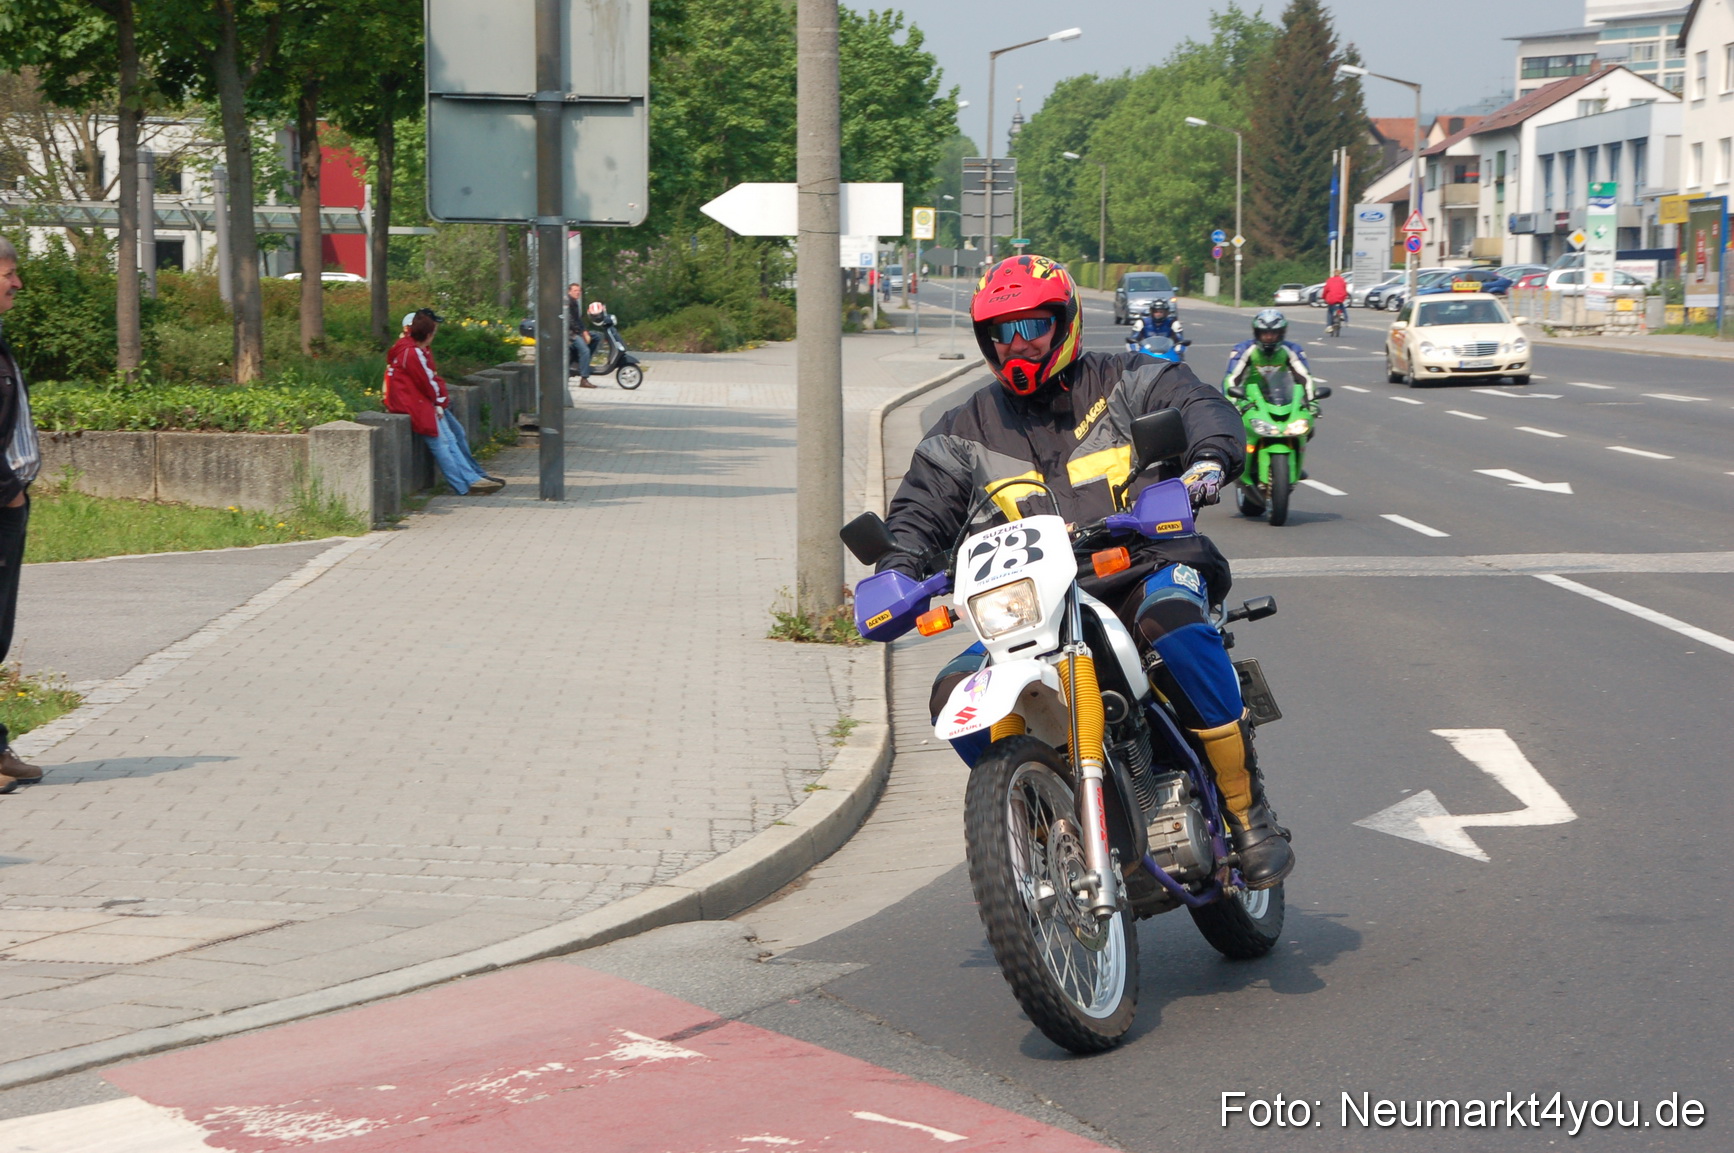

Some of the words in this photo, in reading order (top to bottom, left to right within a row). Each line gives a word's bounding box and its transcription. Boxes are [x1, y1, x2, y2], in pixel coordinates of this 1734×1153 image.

[862, 254, 871, 265] P
[982, 523, 1024, 540] SUZUKI
[968, 528, 1044, 582] 73
[949, 723, 982, 737] SUZUKI
